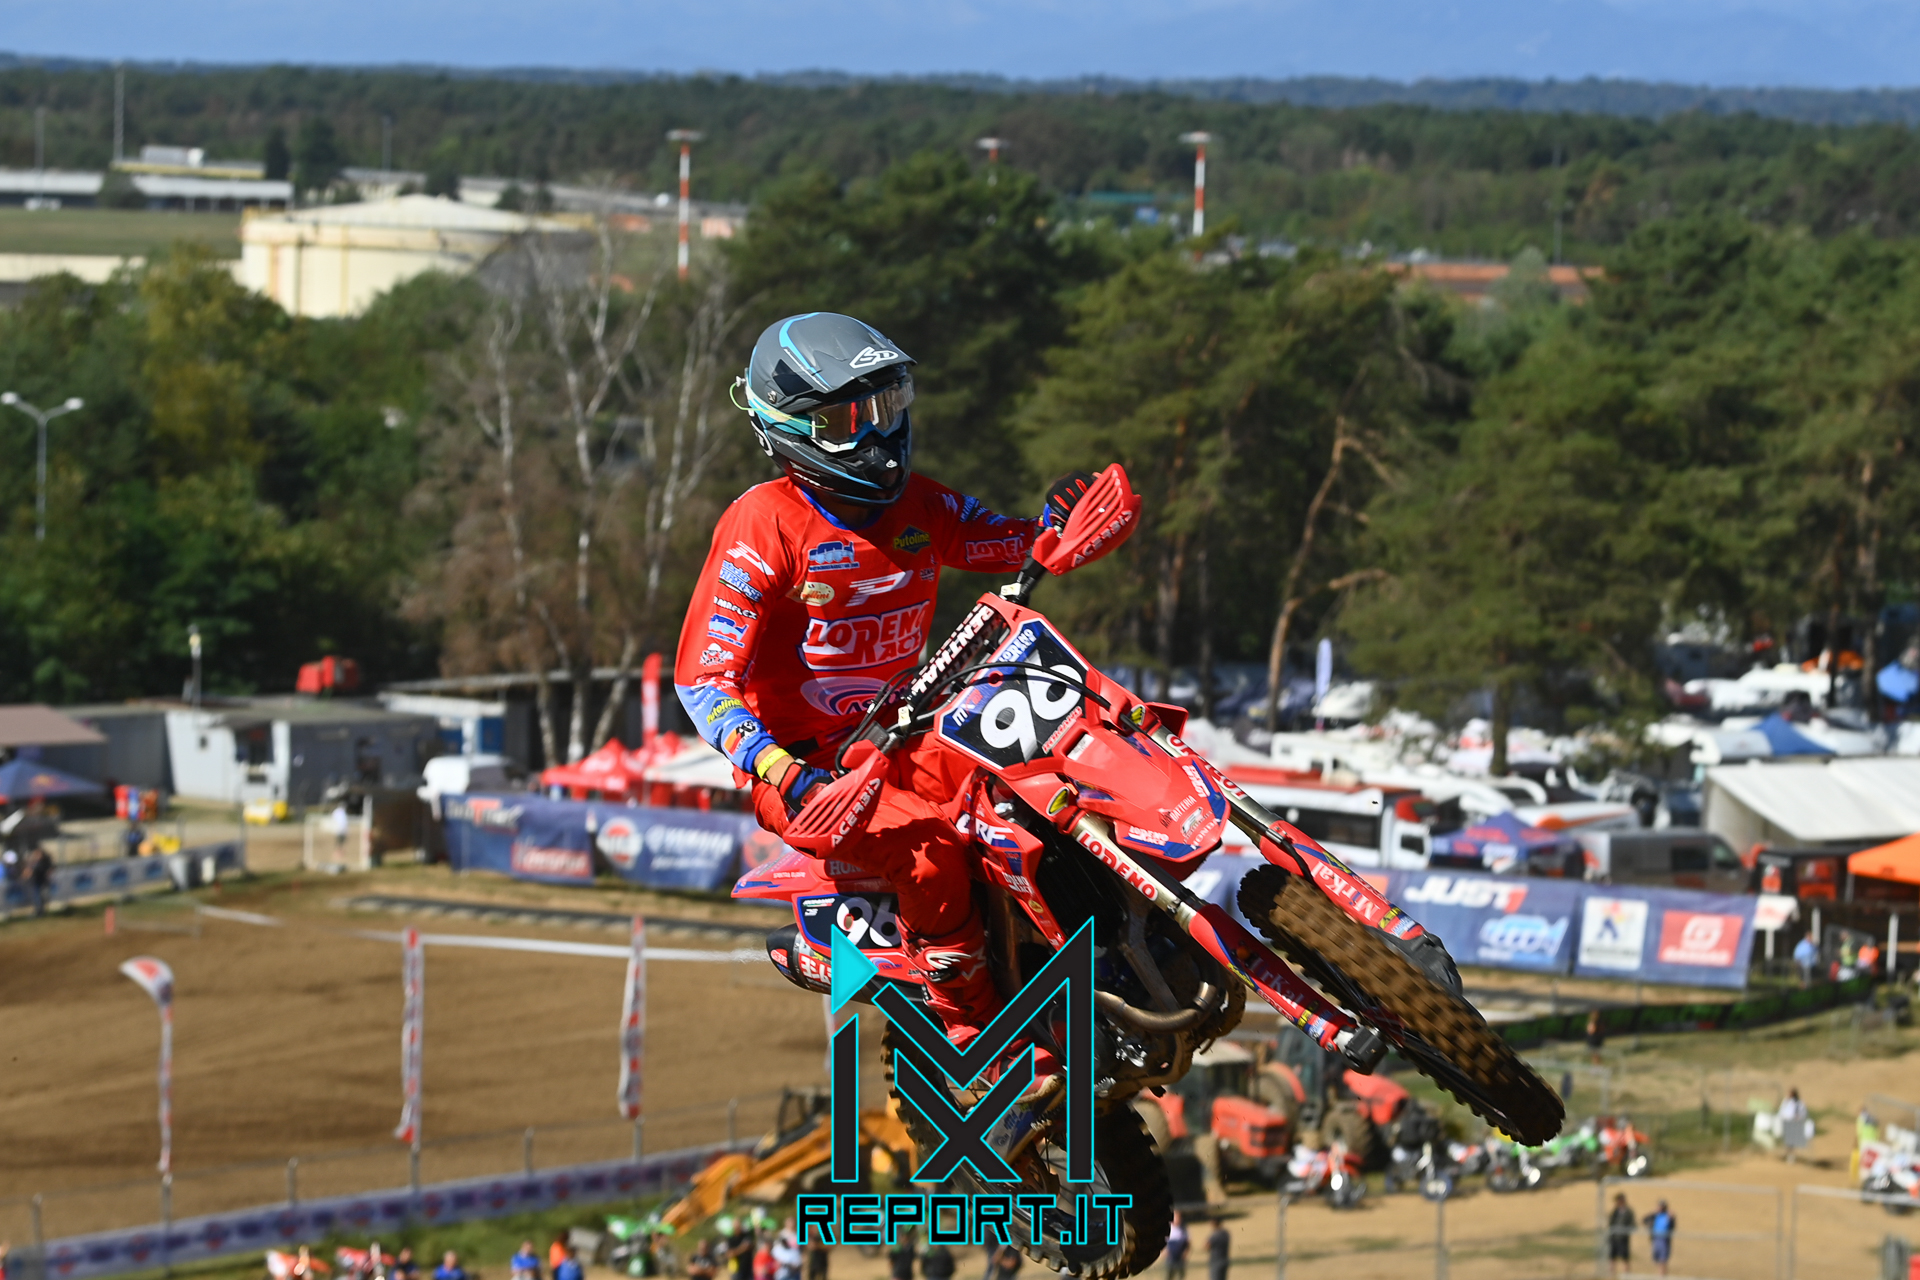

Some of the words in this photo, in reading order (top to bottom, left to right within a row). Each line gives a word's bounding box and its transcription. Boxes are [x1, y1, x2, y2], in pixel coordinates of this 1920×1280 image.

[893, 532, 931, 549] Putoline
[912, 605, 995, 694] RENTHAL
[980, 650, 1083, 766] 96
[1403, 875, 1529, 914] JUST1
[836, 896, 903, 948] 96
